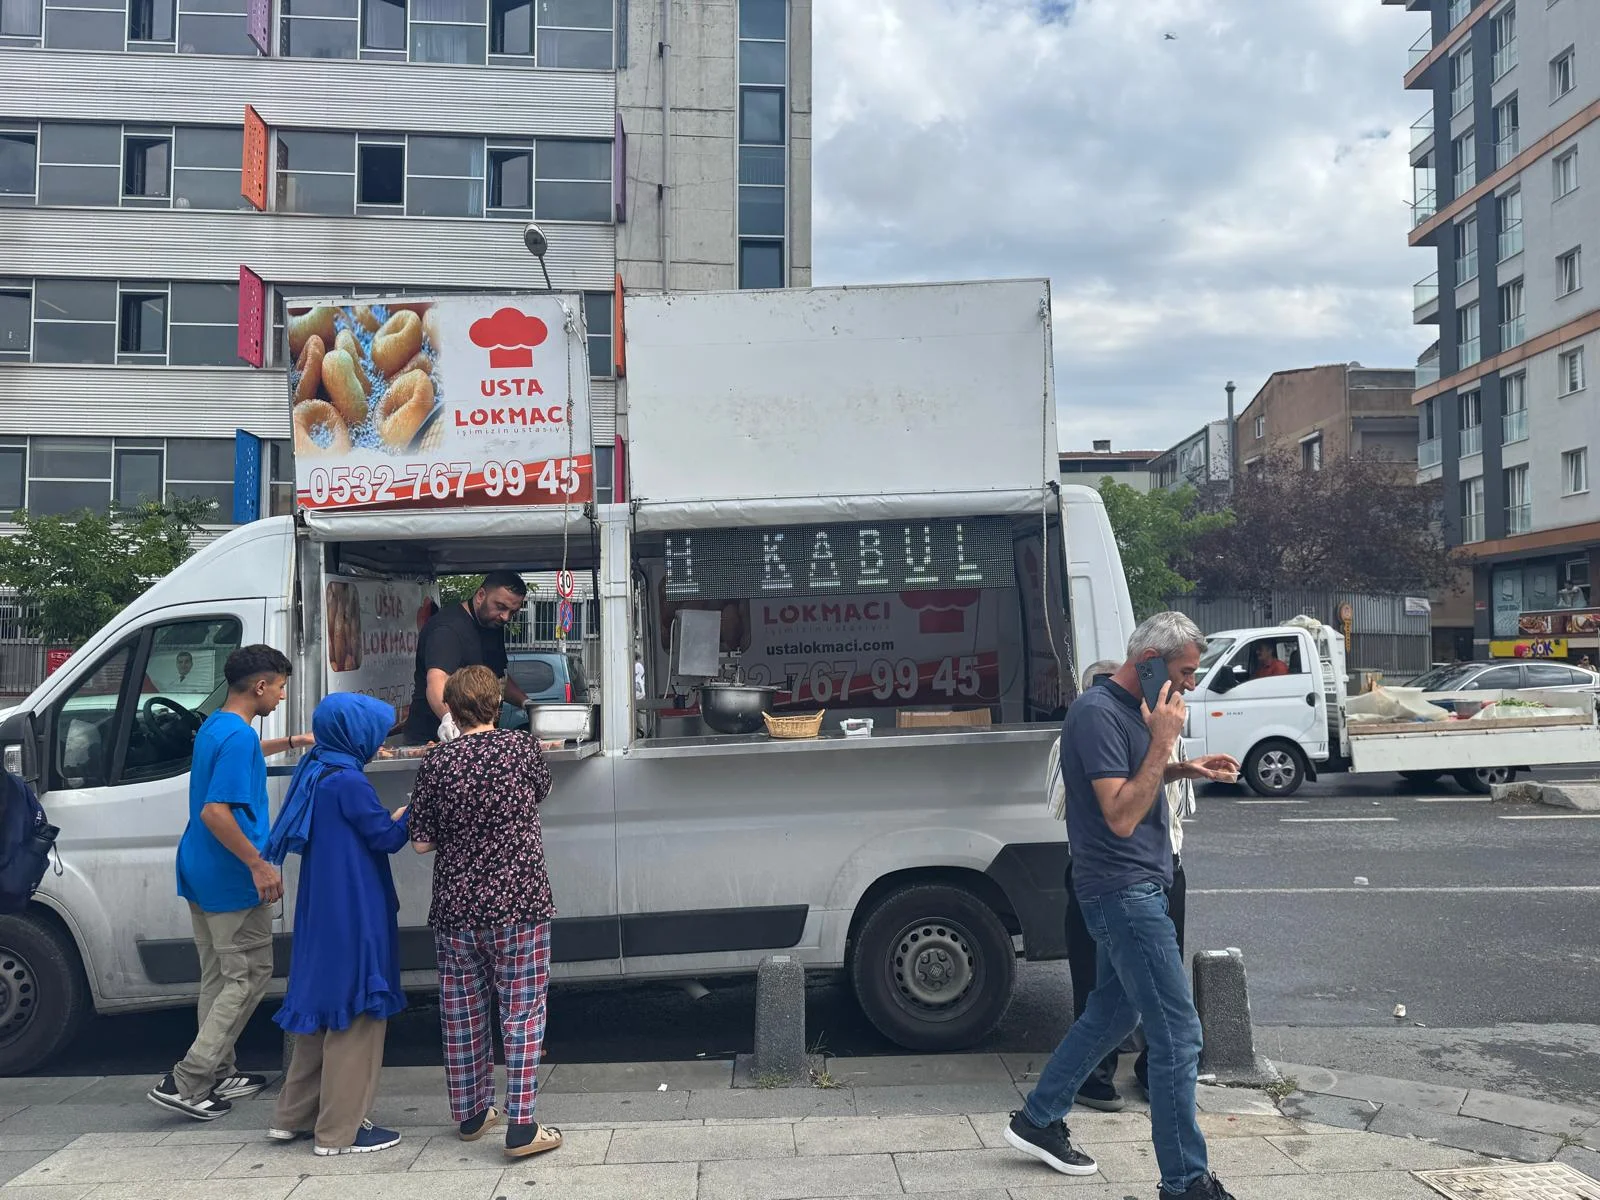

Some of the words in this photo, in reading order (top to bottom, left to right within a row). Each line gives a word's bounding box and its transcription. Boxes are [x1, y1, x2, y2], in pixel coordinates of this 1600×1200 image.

[480, 378, 544, 397] USTA
[309, 464, 396, 504] 0532
[405, 461, 472, 500] 767
[482, 460, 527, 497] 99
[537, 459, 580, 495] 45
[761, 524, 982, 589] KABUL
[763, 601, 890, 625] LOKMACI
[766, 639, 894, 656] ustalokmaci.com
[784, 660, 858, 702] 767
[870, 657, 918, 700] 99
[931, 655, 981, 696] 45
